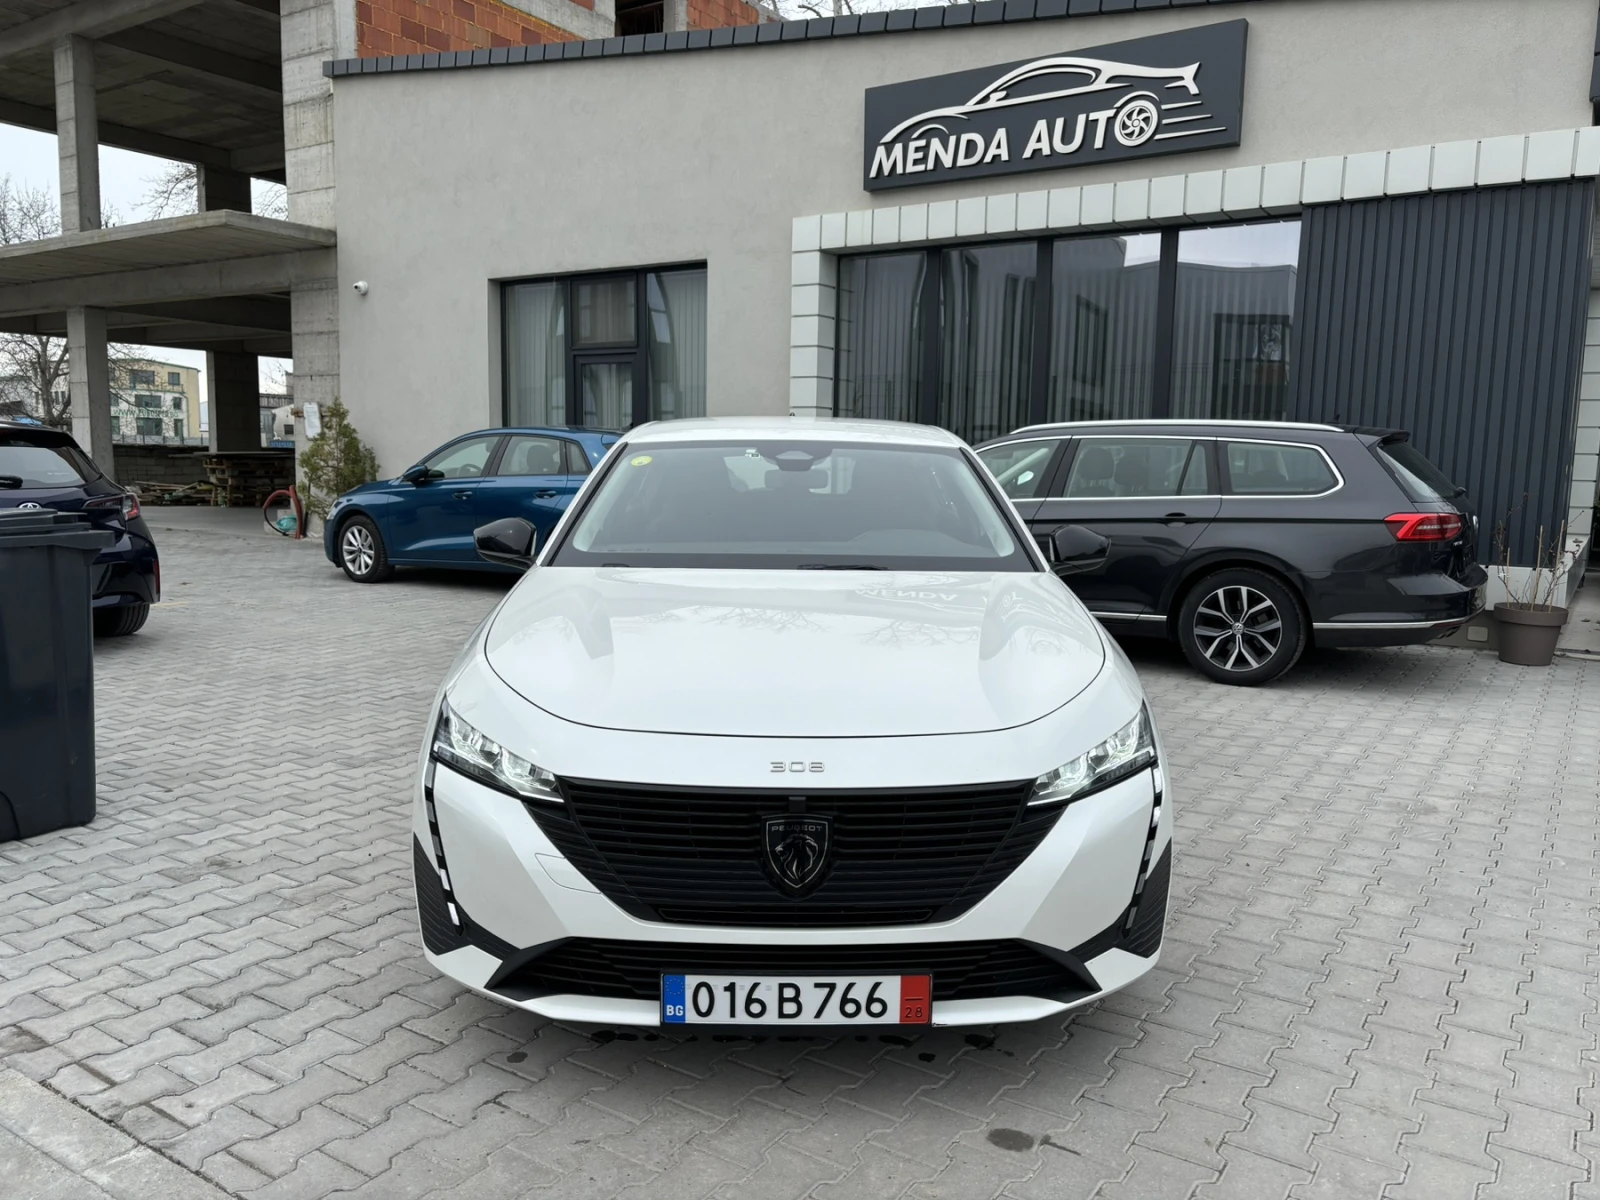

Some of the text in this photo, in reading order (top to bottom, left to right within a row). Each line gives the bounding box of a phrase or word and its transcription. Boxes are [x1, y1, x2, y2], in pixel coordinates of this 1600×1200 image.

[869, 99, 1160, 178] MENDA AUTO
[770, 761, 825, 773] 308
[666, 1004, 684, 1016] BG
[905, 1006, 923, 1018] 28
